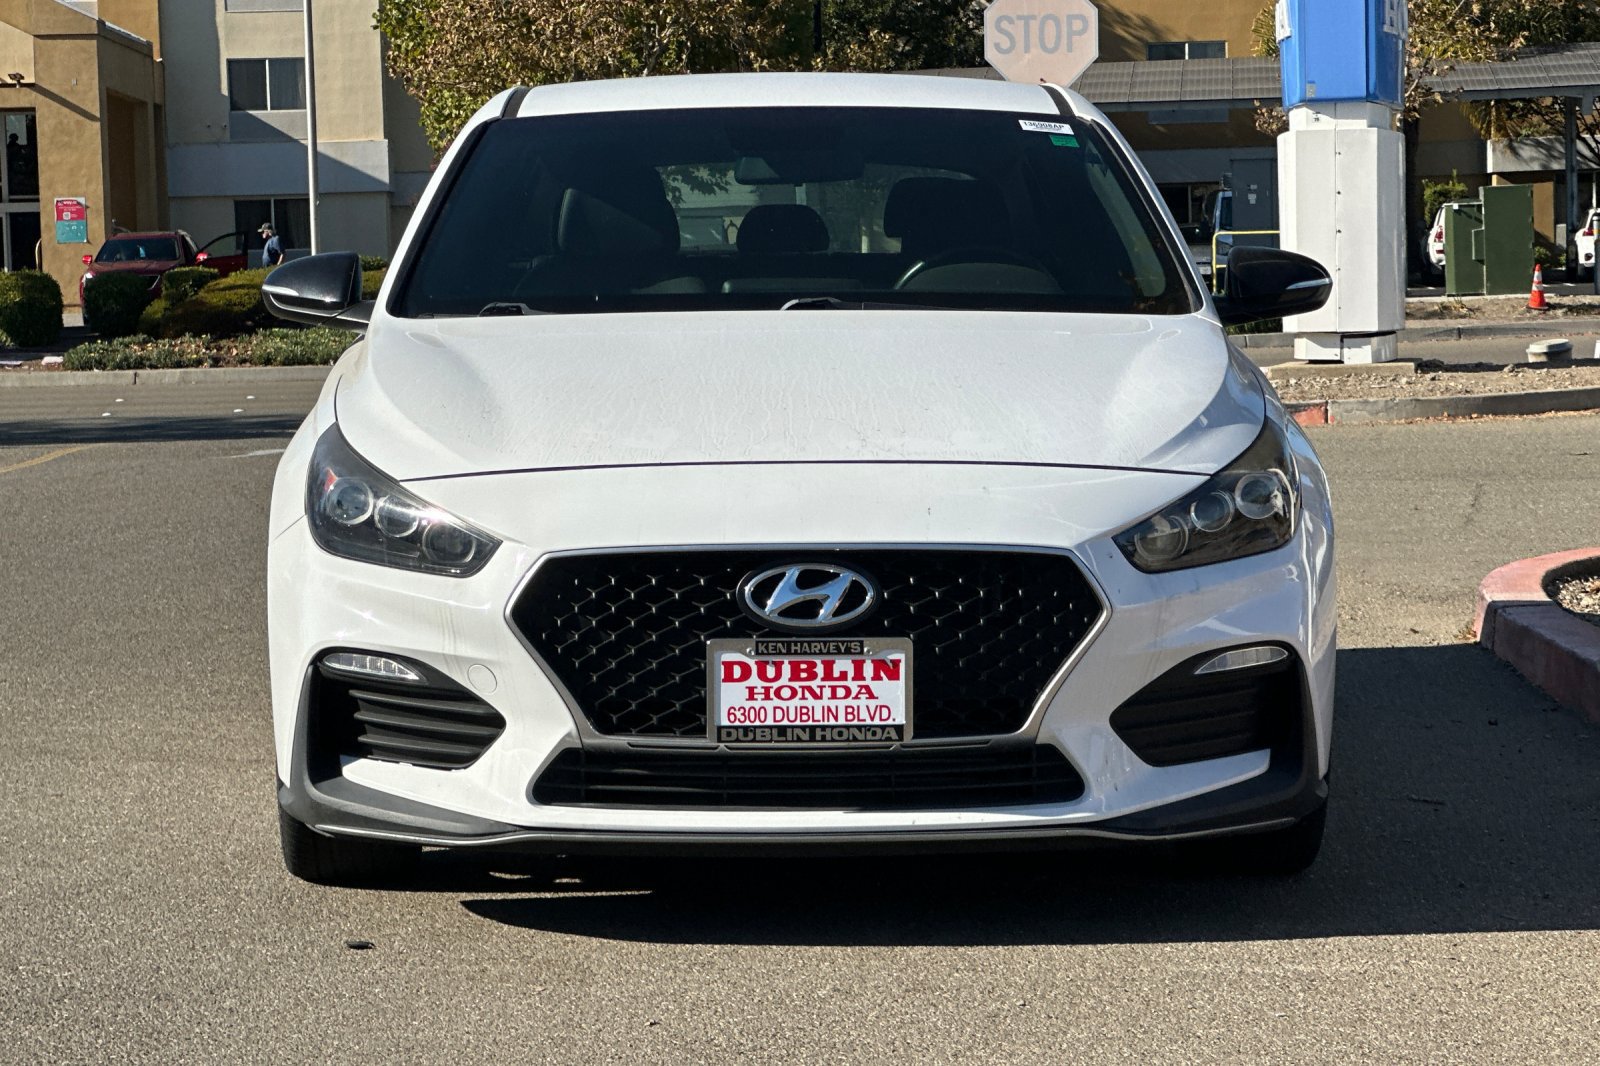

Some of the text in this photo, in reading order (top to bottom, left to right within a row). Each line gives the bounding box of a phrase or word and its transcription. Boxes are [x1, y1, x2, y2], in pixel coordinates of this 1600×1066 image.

[993, 13, 1089, 55] STOP
[758, 641, 861, 654] KEN HARVEY'S
[721, 658, 902, 683] DUBLIN
[745, 685, 879, 701] HONDA
[727, 704, 896, 724] 6300 DUBLIN BLVD.
[720, 727, 899, 741] DUBLIN HONDA
